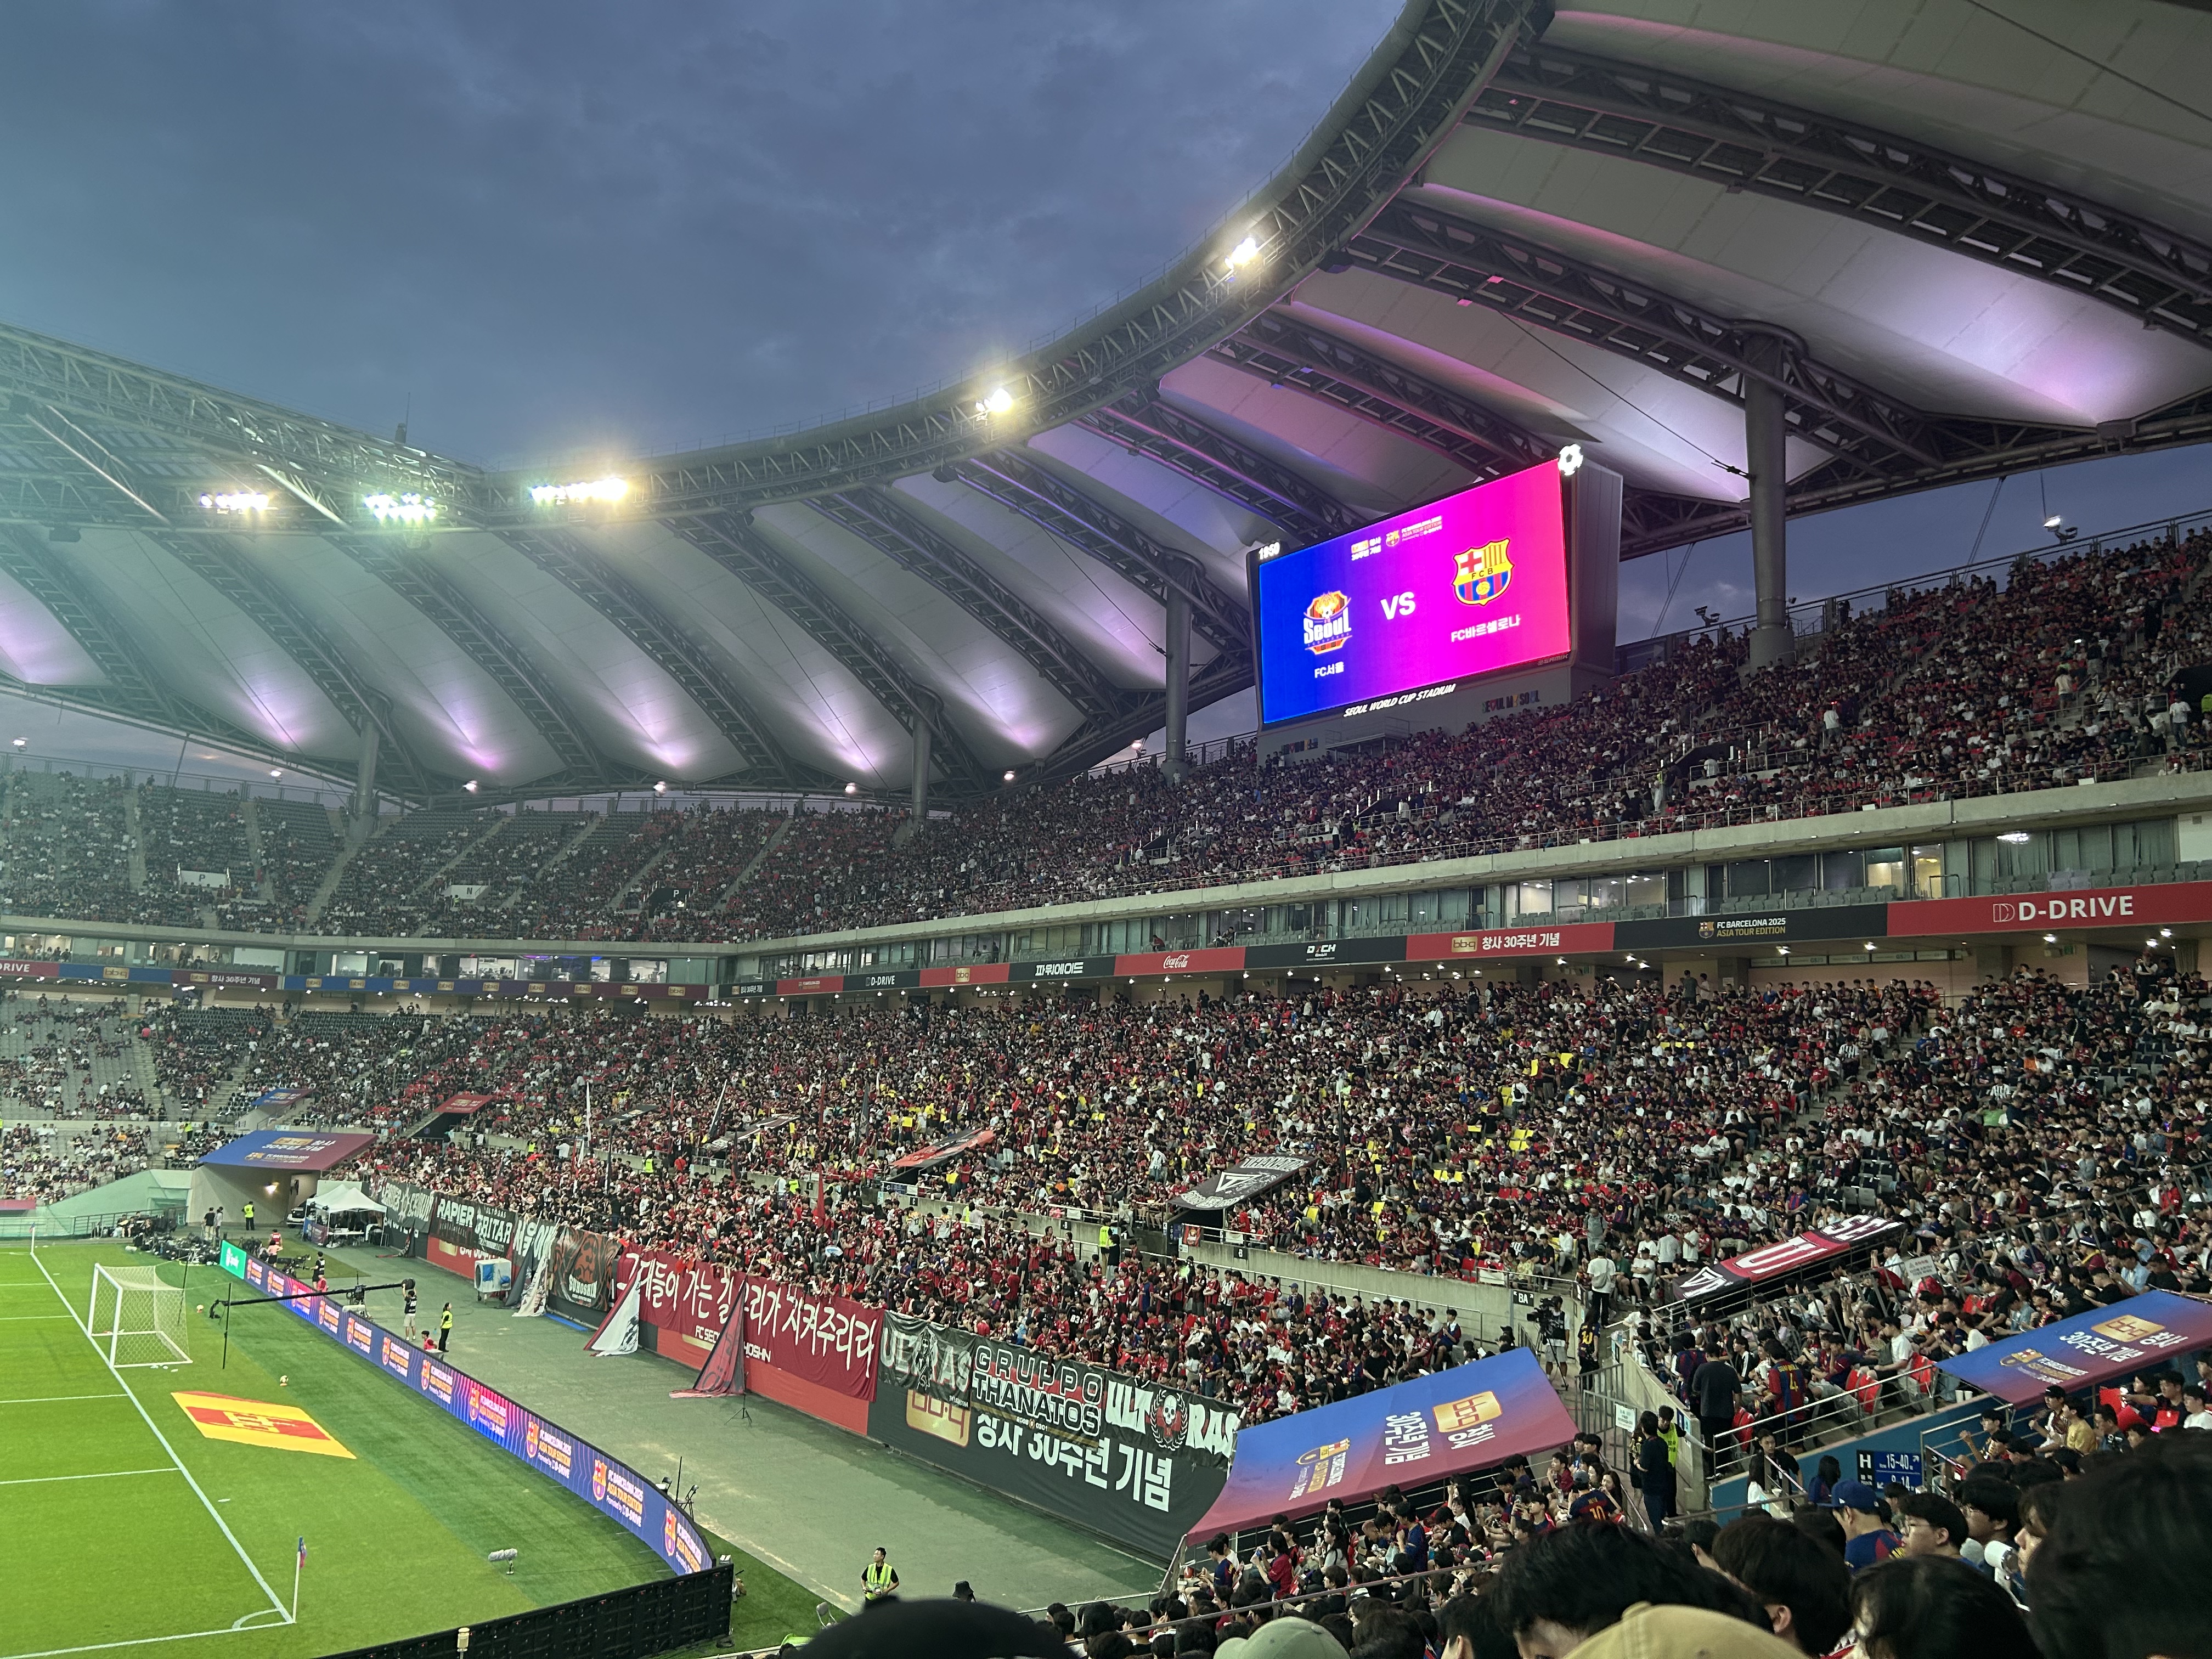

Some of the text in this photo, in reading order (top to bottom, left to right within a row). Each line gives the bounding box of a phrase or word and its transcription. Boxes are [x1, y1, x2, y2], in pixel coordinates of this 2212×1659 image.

[1380, 591, 1415, 620] VS
[1451, 614, 1521, 642] FC바르셀로나
[1314, 661, 1344, 678] FC서울
[1343, 683, 1457, 717] SEOUL WORLD CUP STADIUM
[2018, 895, 2134, 922] D-DRIVE
[1717, 917, 1786, 929] FC BARCELONA 2025
[1717, 926, 1786, 938] ASIA TOUR EDITION
[1482, 936, 1502, 950] 창사
[1504, 934, 1537, 949] 30주년
[1539, 932, 1560, 947] 기념
[225, 975, 247, 984] 30주년
[871, 975, 895, 986] D-DRIVE
[1035, 962, 1084, 977] 파워에이드
[437, 1199, 475, 1228] RAPIER
[569, 1274, 598, 1299] SUHOSHIN
[683, 1268, 713, 1318] 가는
[717, 1273, 735, 1324] 길
[695, 1325, 704, 1340] FC
[2140, 1331, 2188, 1348] 창사
[2059, 1331, 2145, 1362] 30주년 기념
[975, 1345, 1103, 1405] GRUPPO
[1790, 1373, 1798, 1392] 4
[972, 1370, 1102, 1436] THANATOS
[1384, 1411, 1431, 1465] 30주년 기념
[1448, 1423, 1496, 1450] 창사
[1859, 1453, 1871, 1469] H
[608, 1469, 644, 1502] FC BARCELONA 2025
[1115, 1442, 1172, 1513] 기념
[607, 1481, 642, 1515] ASIA TOUR EDITION
[625, 1506, 642, 1527] D-DRIVE
